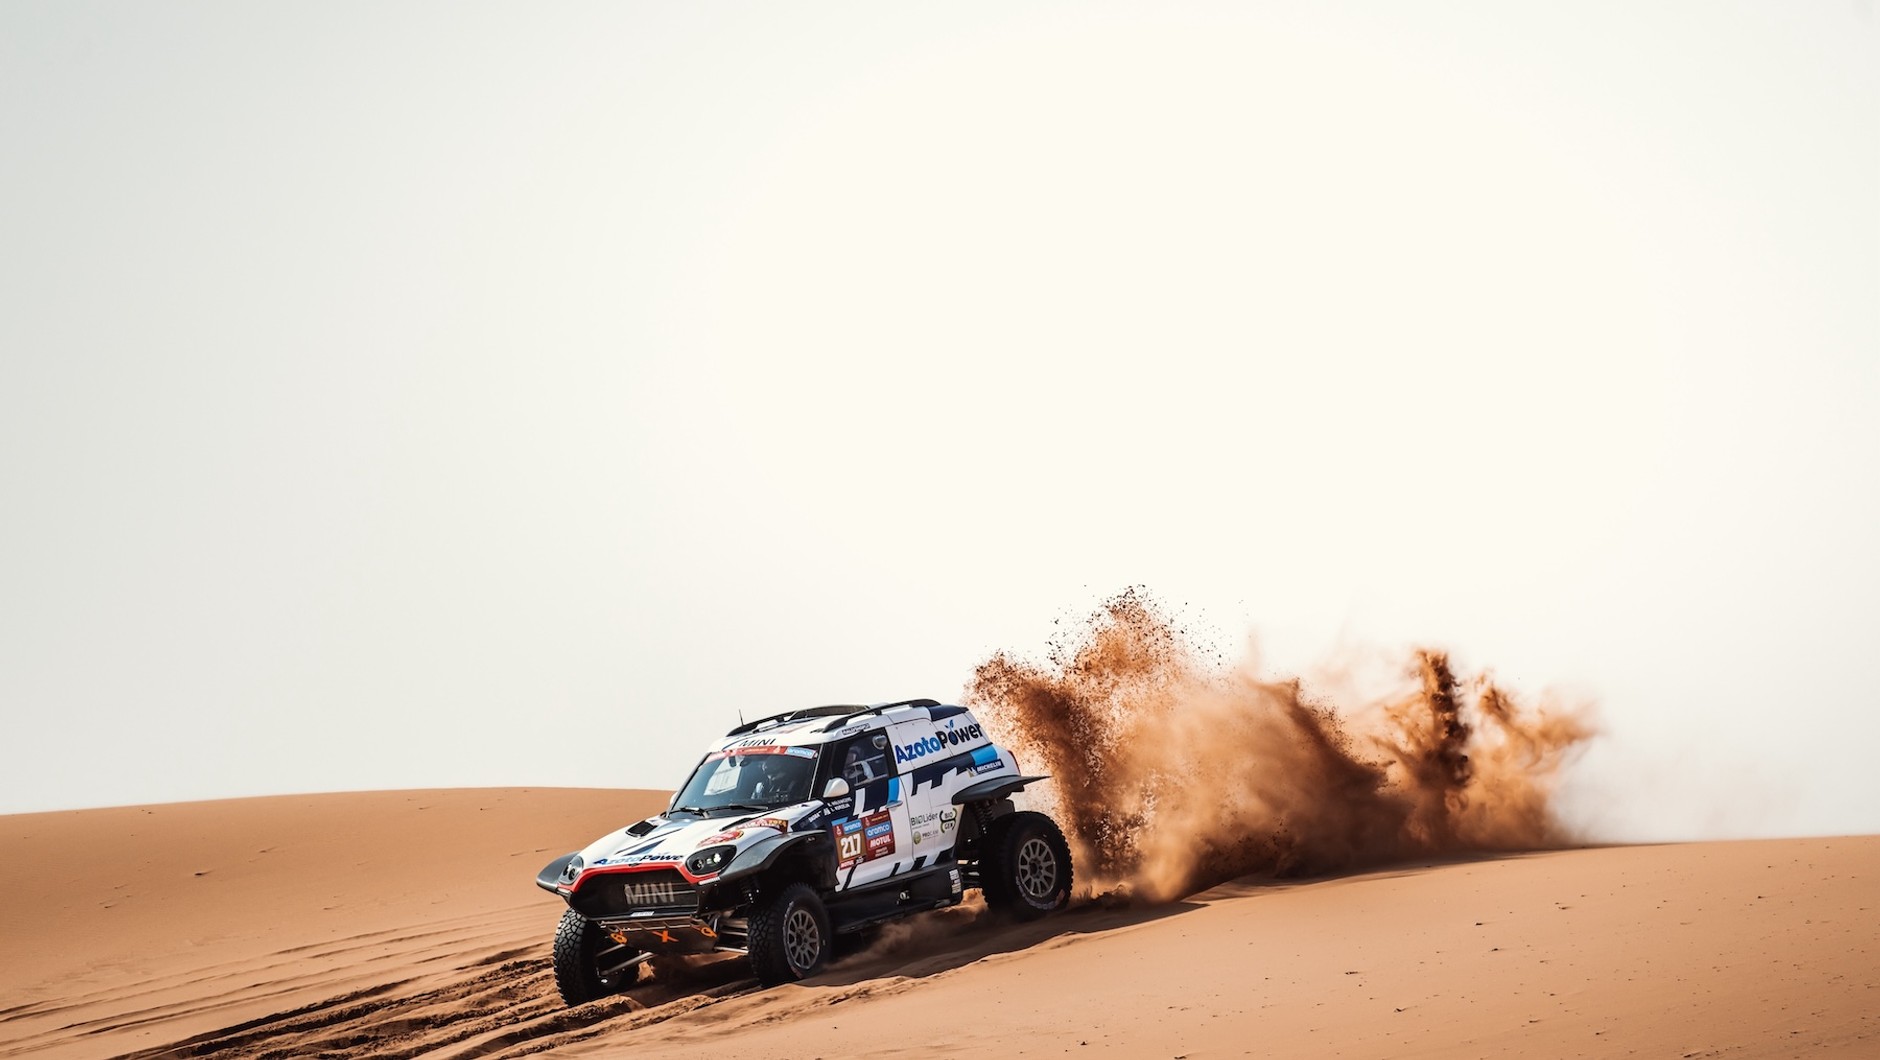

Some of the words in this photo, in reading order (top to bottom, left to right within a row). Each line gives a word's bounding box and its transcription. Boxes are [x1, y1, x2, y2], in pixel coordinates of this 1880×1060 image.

[739, 738, 776, 747] MINI
[895, 720, 983, 764] AzotoPower
[976, 760, 1002, 773] MICHELIN
[844, 822, 860, 831] aramco
[867, 824, 890, 836] aramco
[841, 833, 861, 859] 217
[870, 834, 891, 848] MOTUL
[624, 882, 675, 905] MINI
